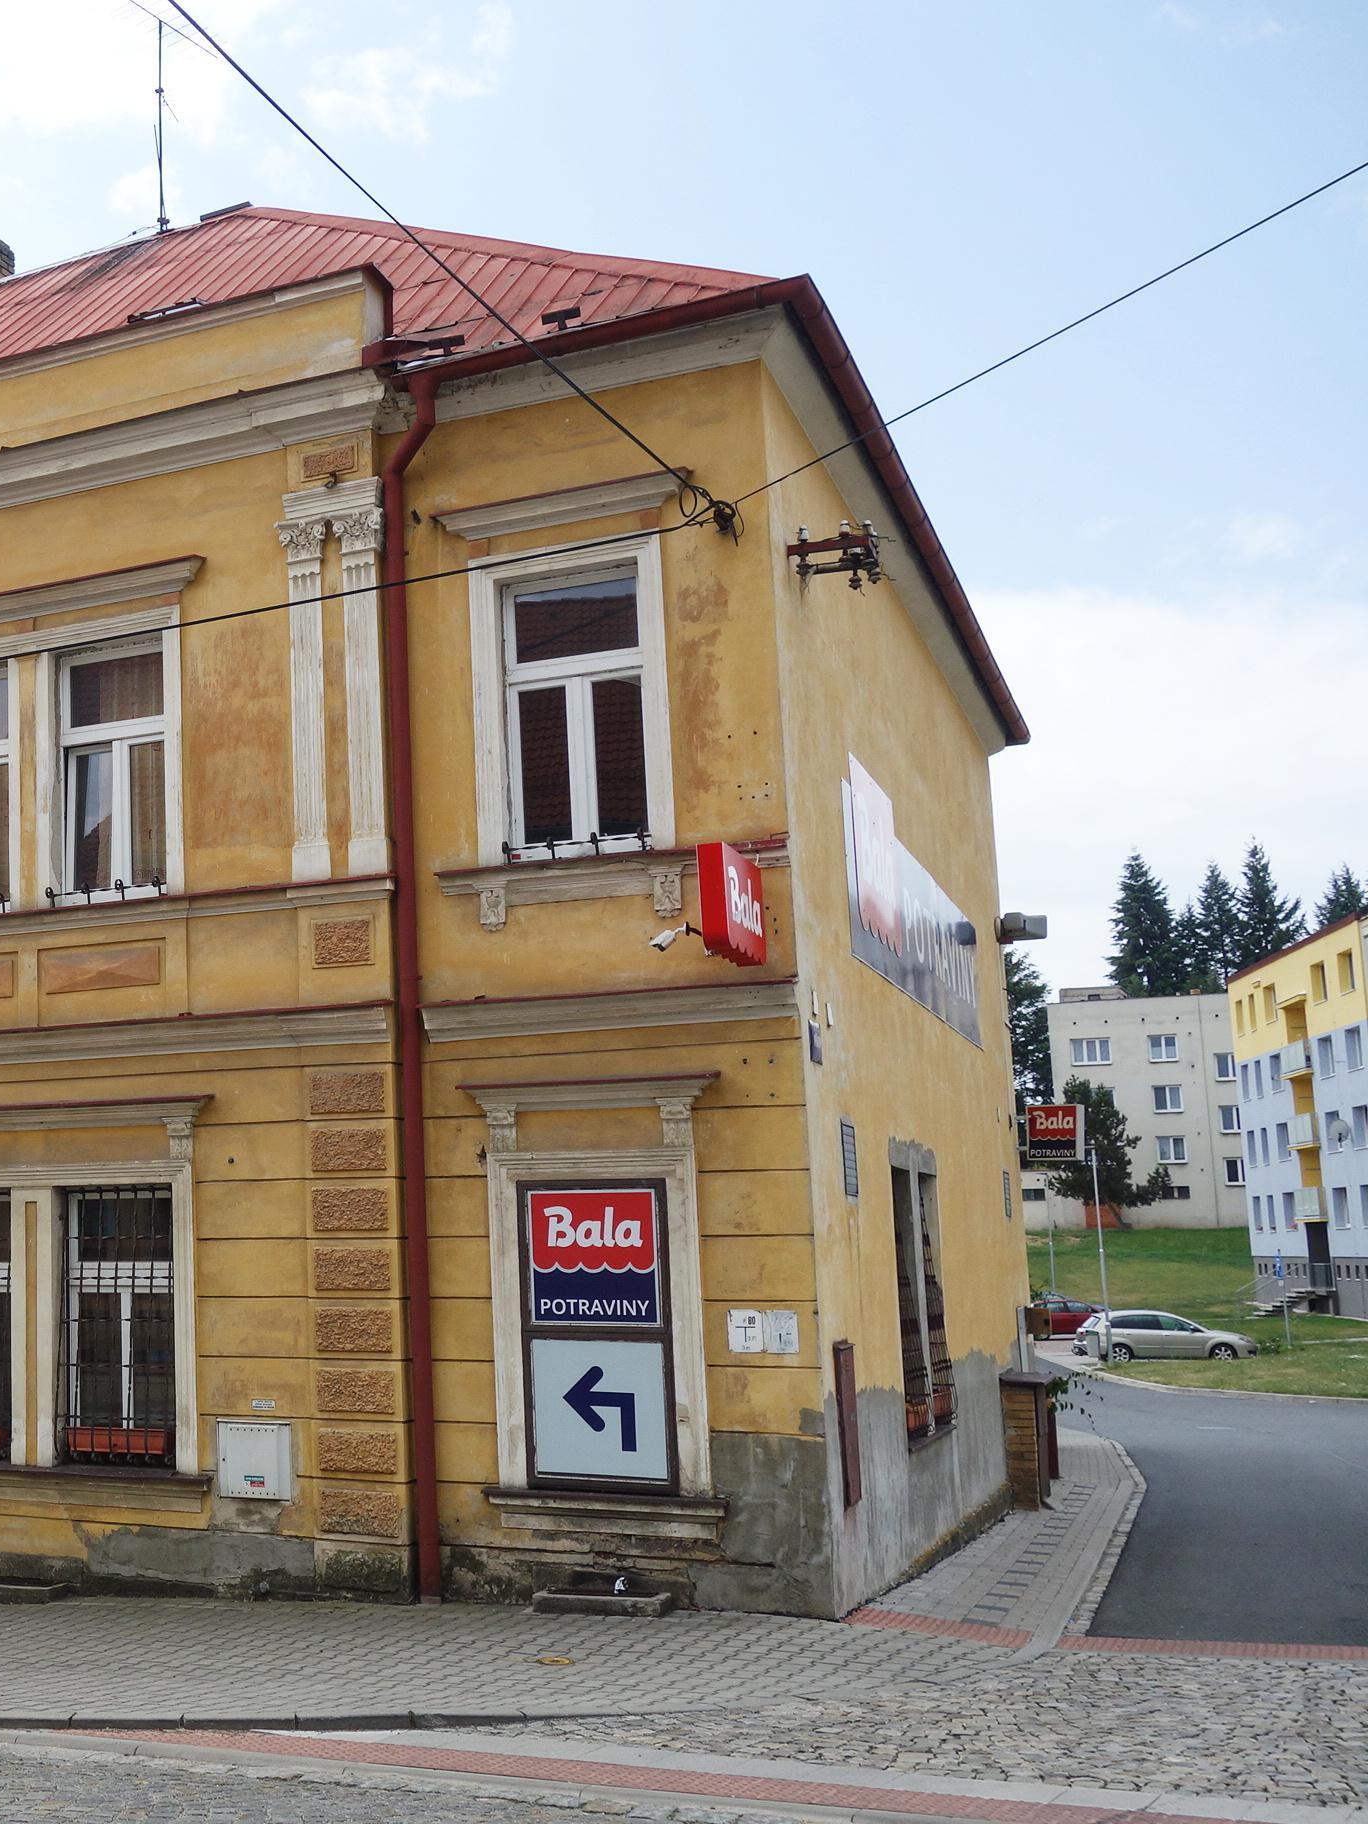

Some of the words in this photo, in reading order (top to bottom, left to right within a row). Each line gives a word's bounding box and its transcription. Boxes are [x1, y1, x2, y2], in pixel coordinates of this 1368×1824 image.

[728, 865, 762, 938] Bala
[1032, 1111, 1074, 1130] Bala
[1030, 1149, 1075, 1157] POTRAVINY
[543, 1205, 643, 1248] Bala
[540, 1299, 650, 1316] POTRAVINY
